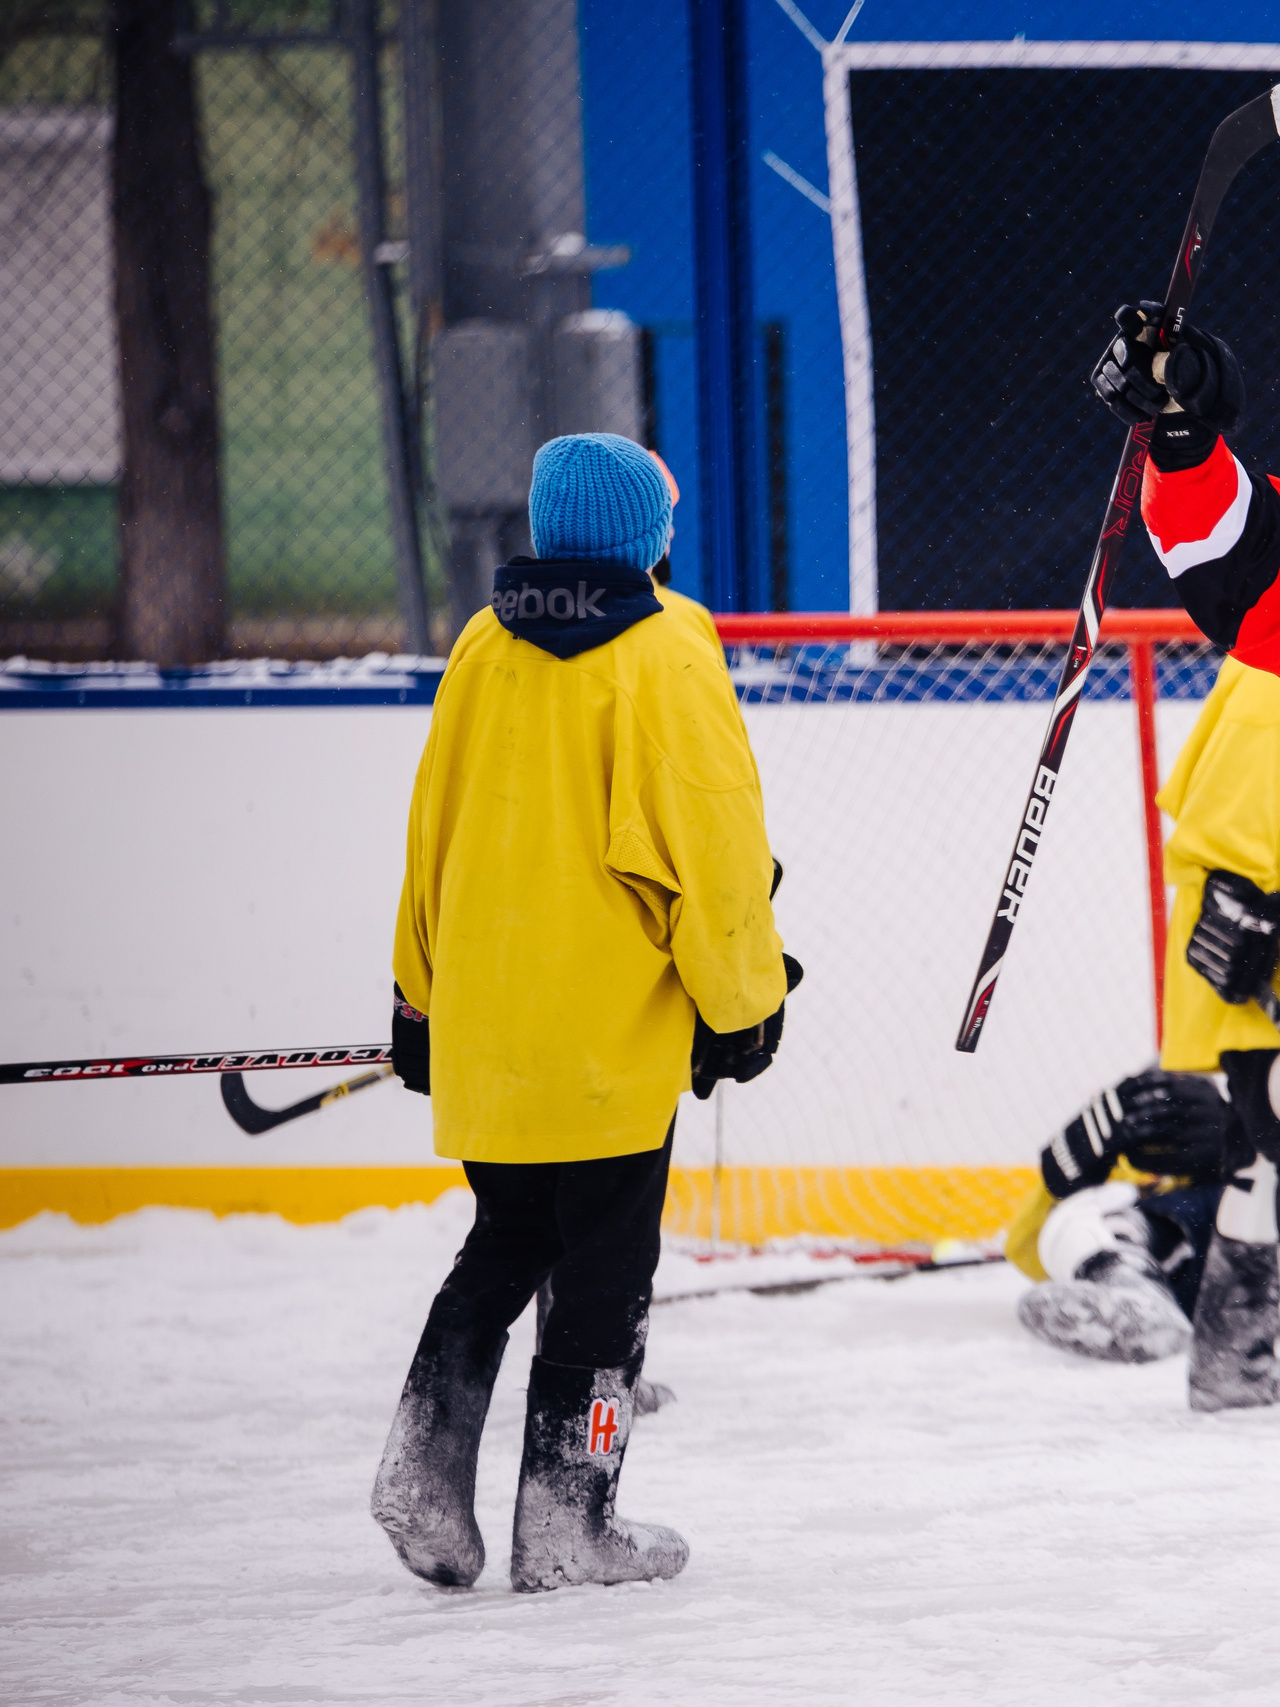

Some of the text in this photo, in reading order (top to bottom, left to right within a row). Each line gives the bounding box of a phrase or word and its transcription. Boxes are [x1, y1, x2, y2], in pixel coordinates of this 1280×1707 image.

[1173, 307, 1186, 332] LITE
[141, 1062, 190, 1073] PRO
[191, 1048, 393, 1071] COUVER
